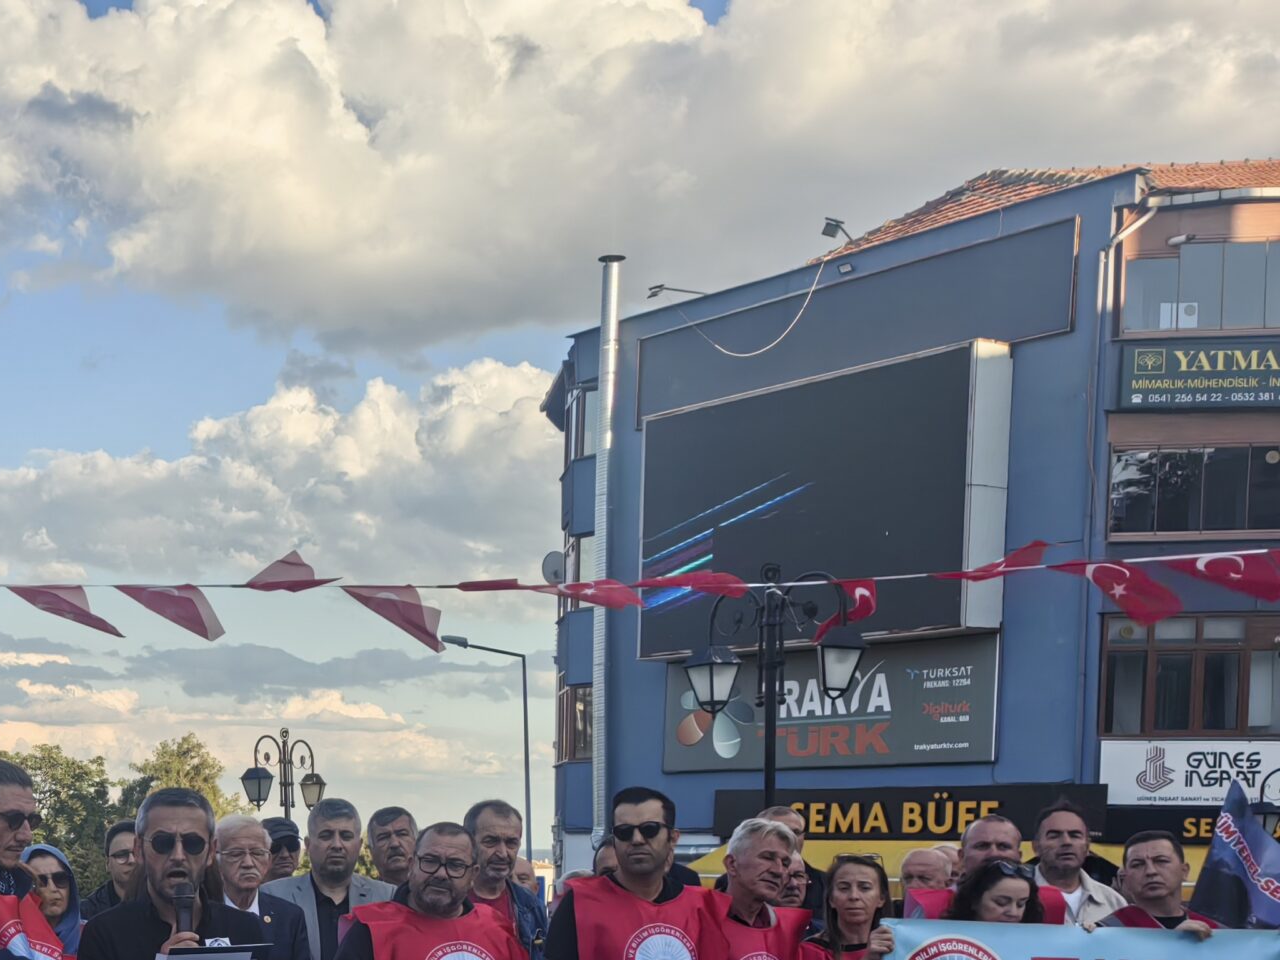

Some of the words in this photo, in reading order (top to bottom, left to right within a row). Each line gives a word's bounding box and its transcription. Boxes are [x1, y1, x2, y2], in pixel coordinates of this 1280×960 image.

[1148, 394, 1170, 403] 0541
[1195, 394, 1207, 402] 54
[1210, 393, 1222, 402] 22
[1231, 393, 1254, 401] 0532
